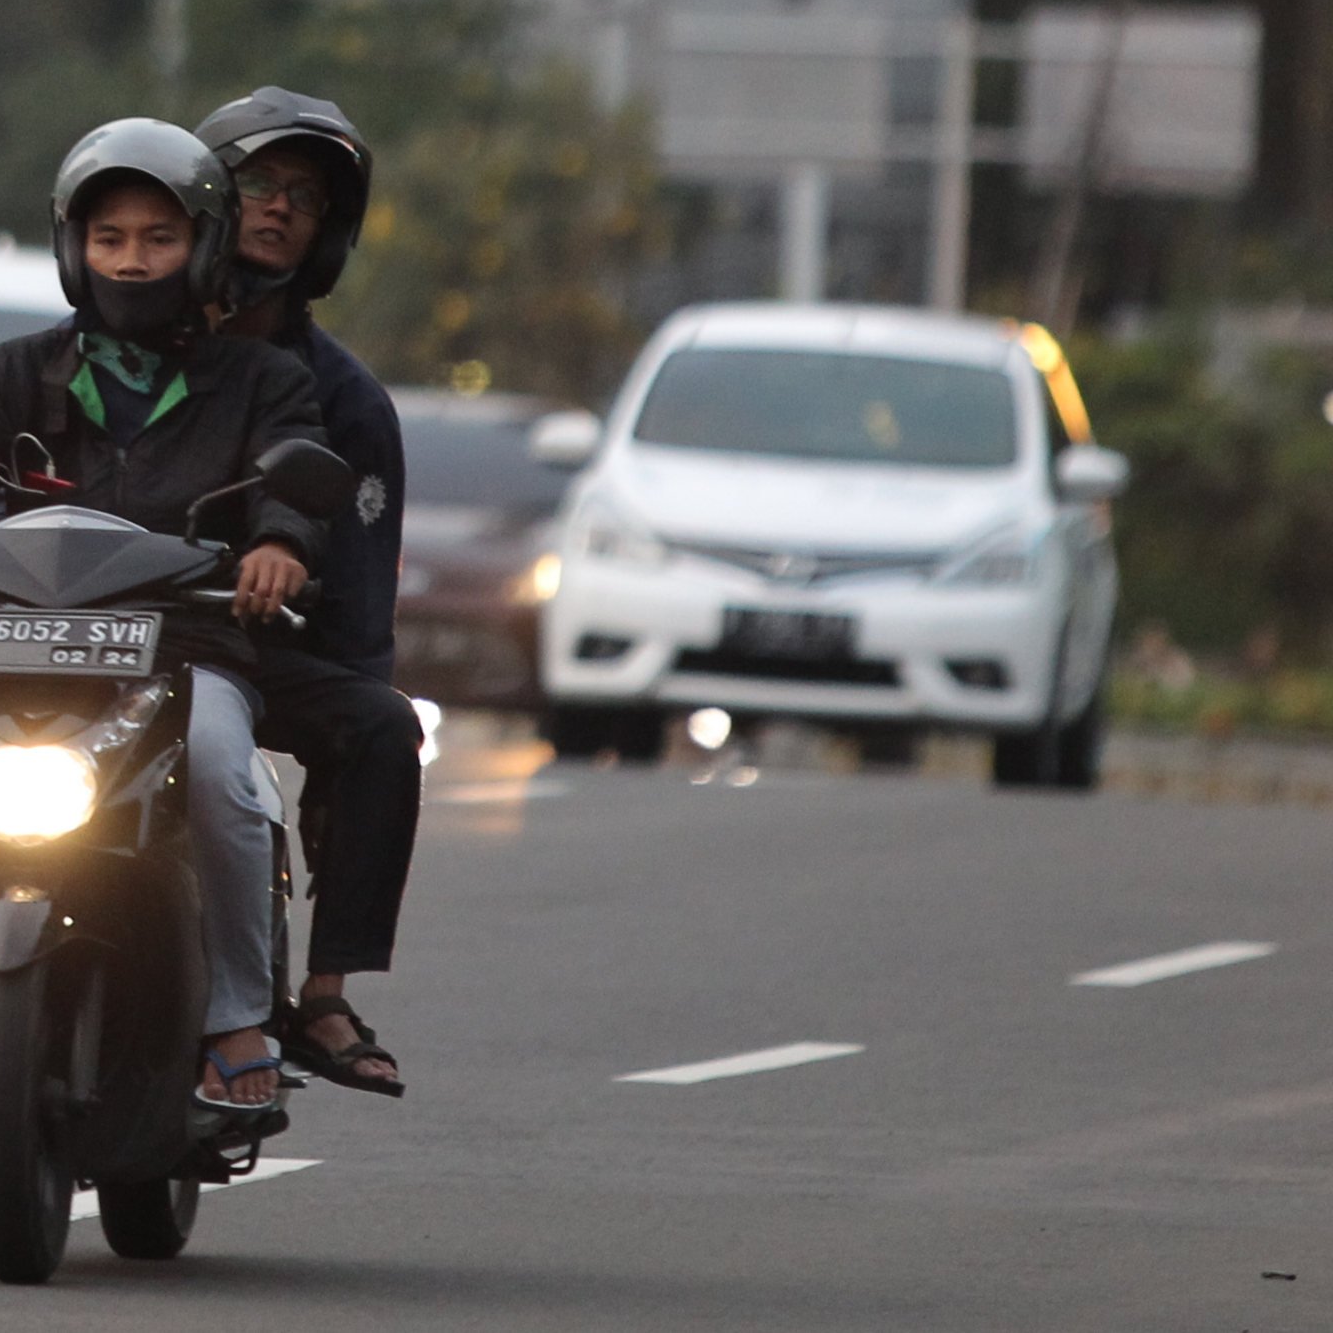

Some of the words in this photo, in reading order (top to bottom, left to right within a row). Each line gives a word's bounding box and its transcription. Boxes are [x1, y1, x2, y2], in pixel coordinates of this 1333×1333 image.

[88, 622, 150, 645] SVH
[51, 649, 87, 664] 02
[103, 651, 138, 665] 24
